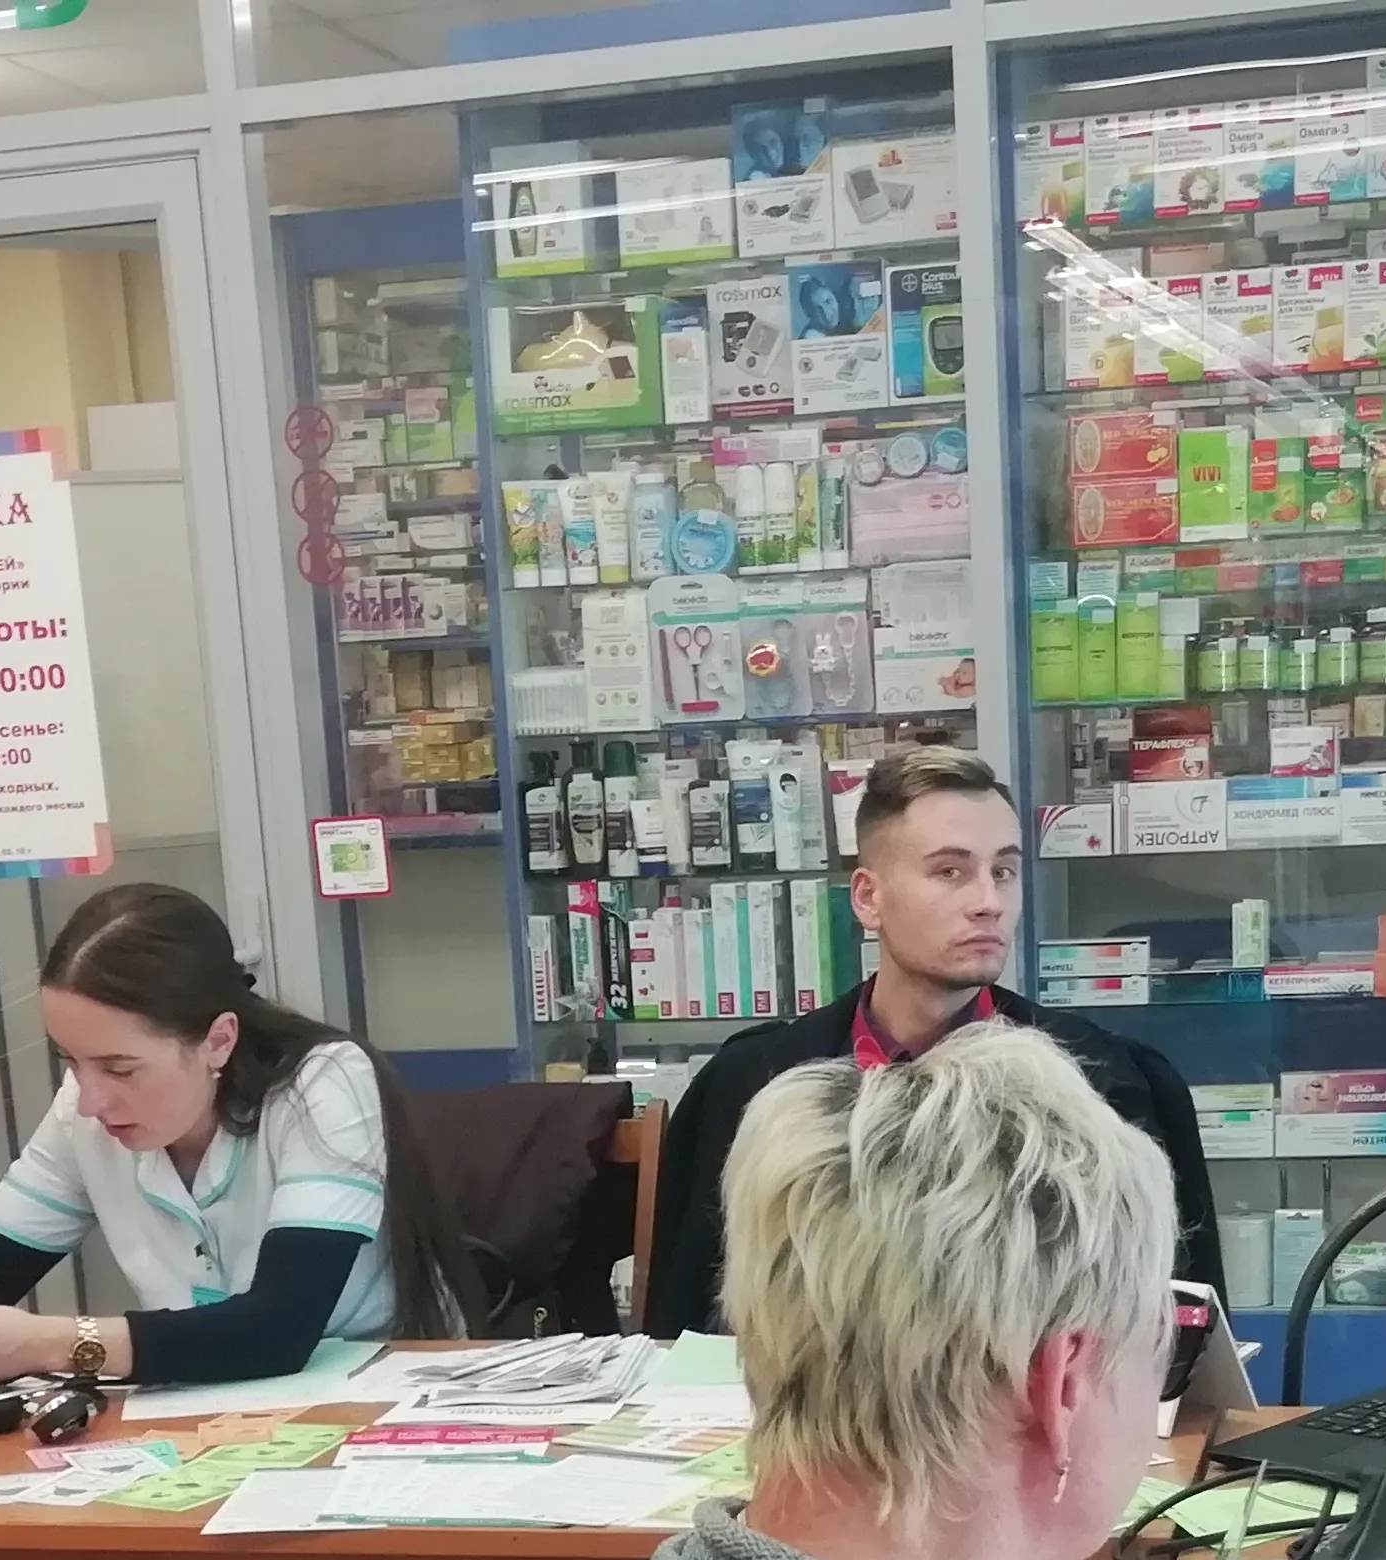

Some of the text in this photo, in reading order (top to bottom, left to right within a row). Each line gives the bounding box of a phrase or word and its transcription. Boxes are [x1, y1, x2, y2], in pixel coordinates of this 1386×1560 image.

[1229, 131, 1264, 144] Омега
[1299, 123, 1350, 139] Омега-3
[1313, 272, 1340, 283] aktiv
[716, 284, 781, 303] rossmax
[1170, 284, 1199, 295] aktiv
[1207, 303, 1268, 316] Менопауза
[1133, 738, 1196, 751] ТЕРАФЛЕКС
[1233, 804, 1335, 819] ХОНДРОМЕД ПЛЮС
[1135, 830, 1219, 847] АРТРОЛЕК
[610, 982, 628, 1010] 32
